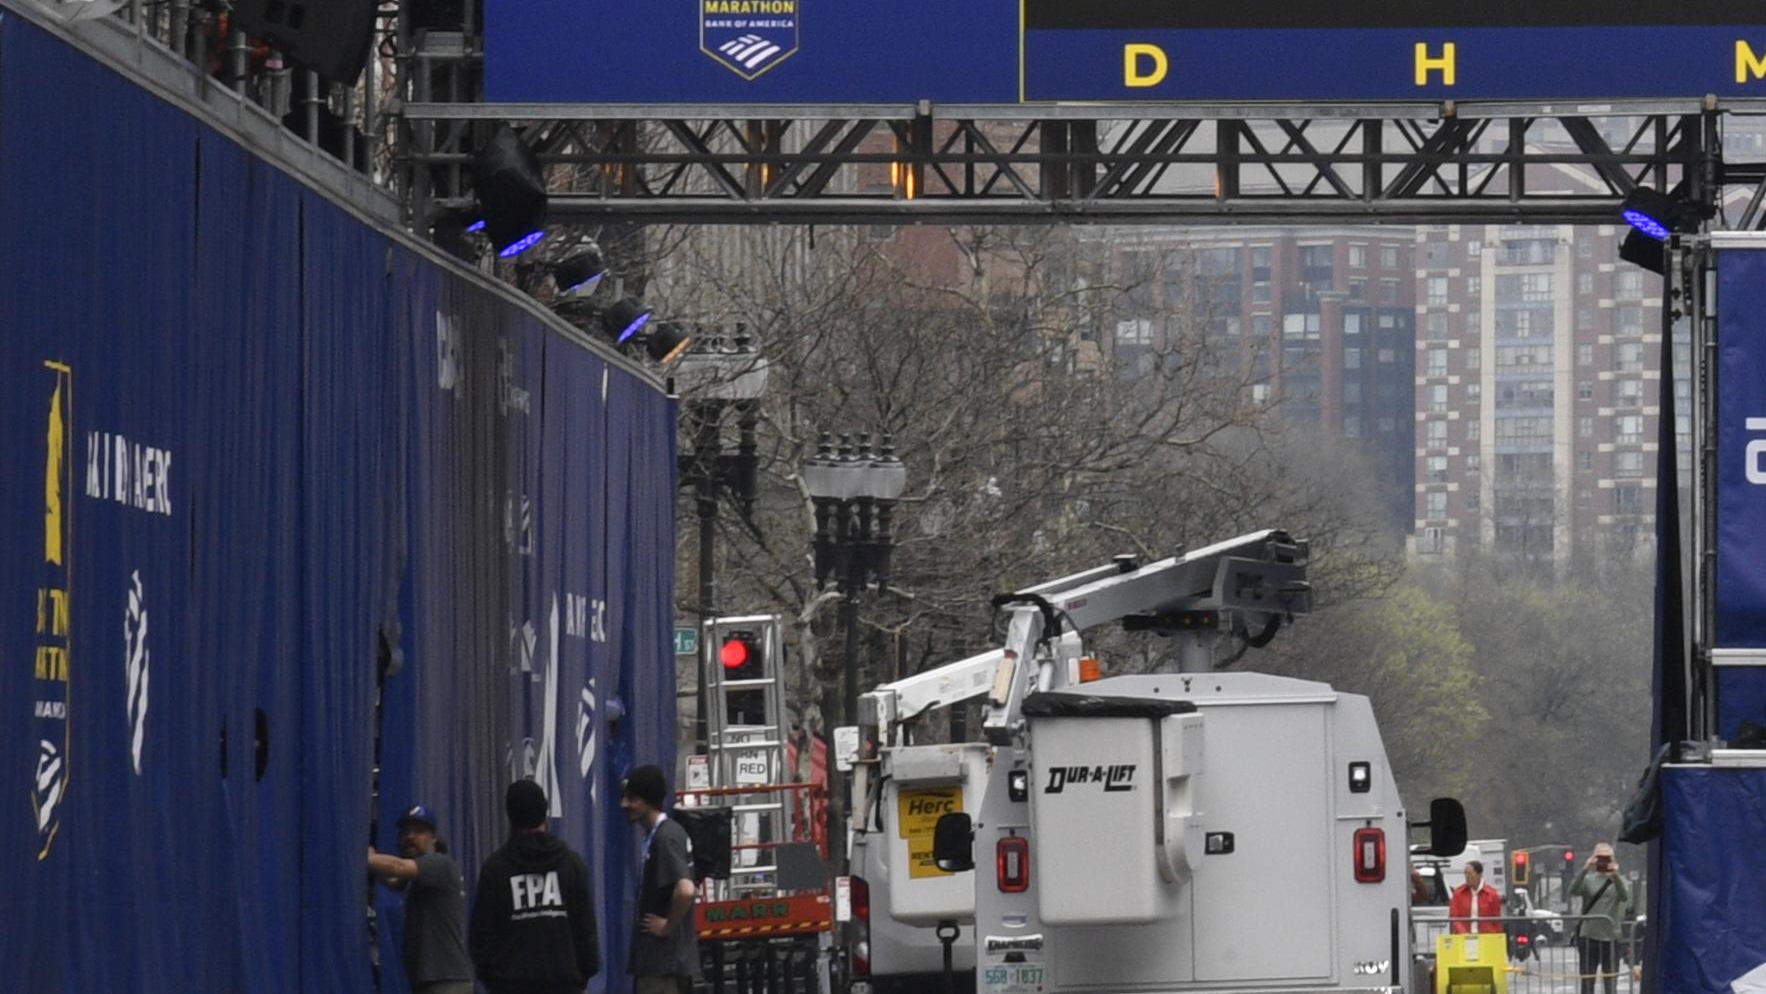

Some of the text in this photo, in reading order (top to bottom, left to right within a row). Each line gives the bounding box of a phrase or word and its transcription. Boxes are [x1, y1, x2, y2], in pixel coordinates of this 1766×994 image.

[704, 0, 794, 14] MARATHON
[704, 19, 794, 28] BANK OF AMERICA
[1124, 43, 1168, 87] D
[1415, 42, 1455, 86] H
[739, 762, 766, 774] RED
[907, 797, 955, 816] Herc
